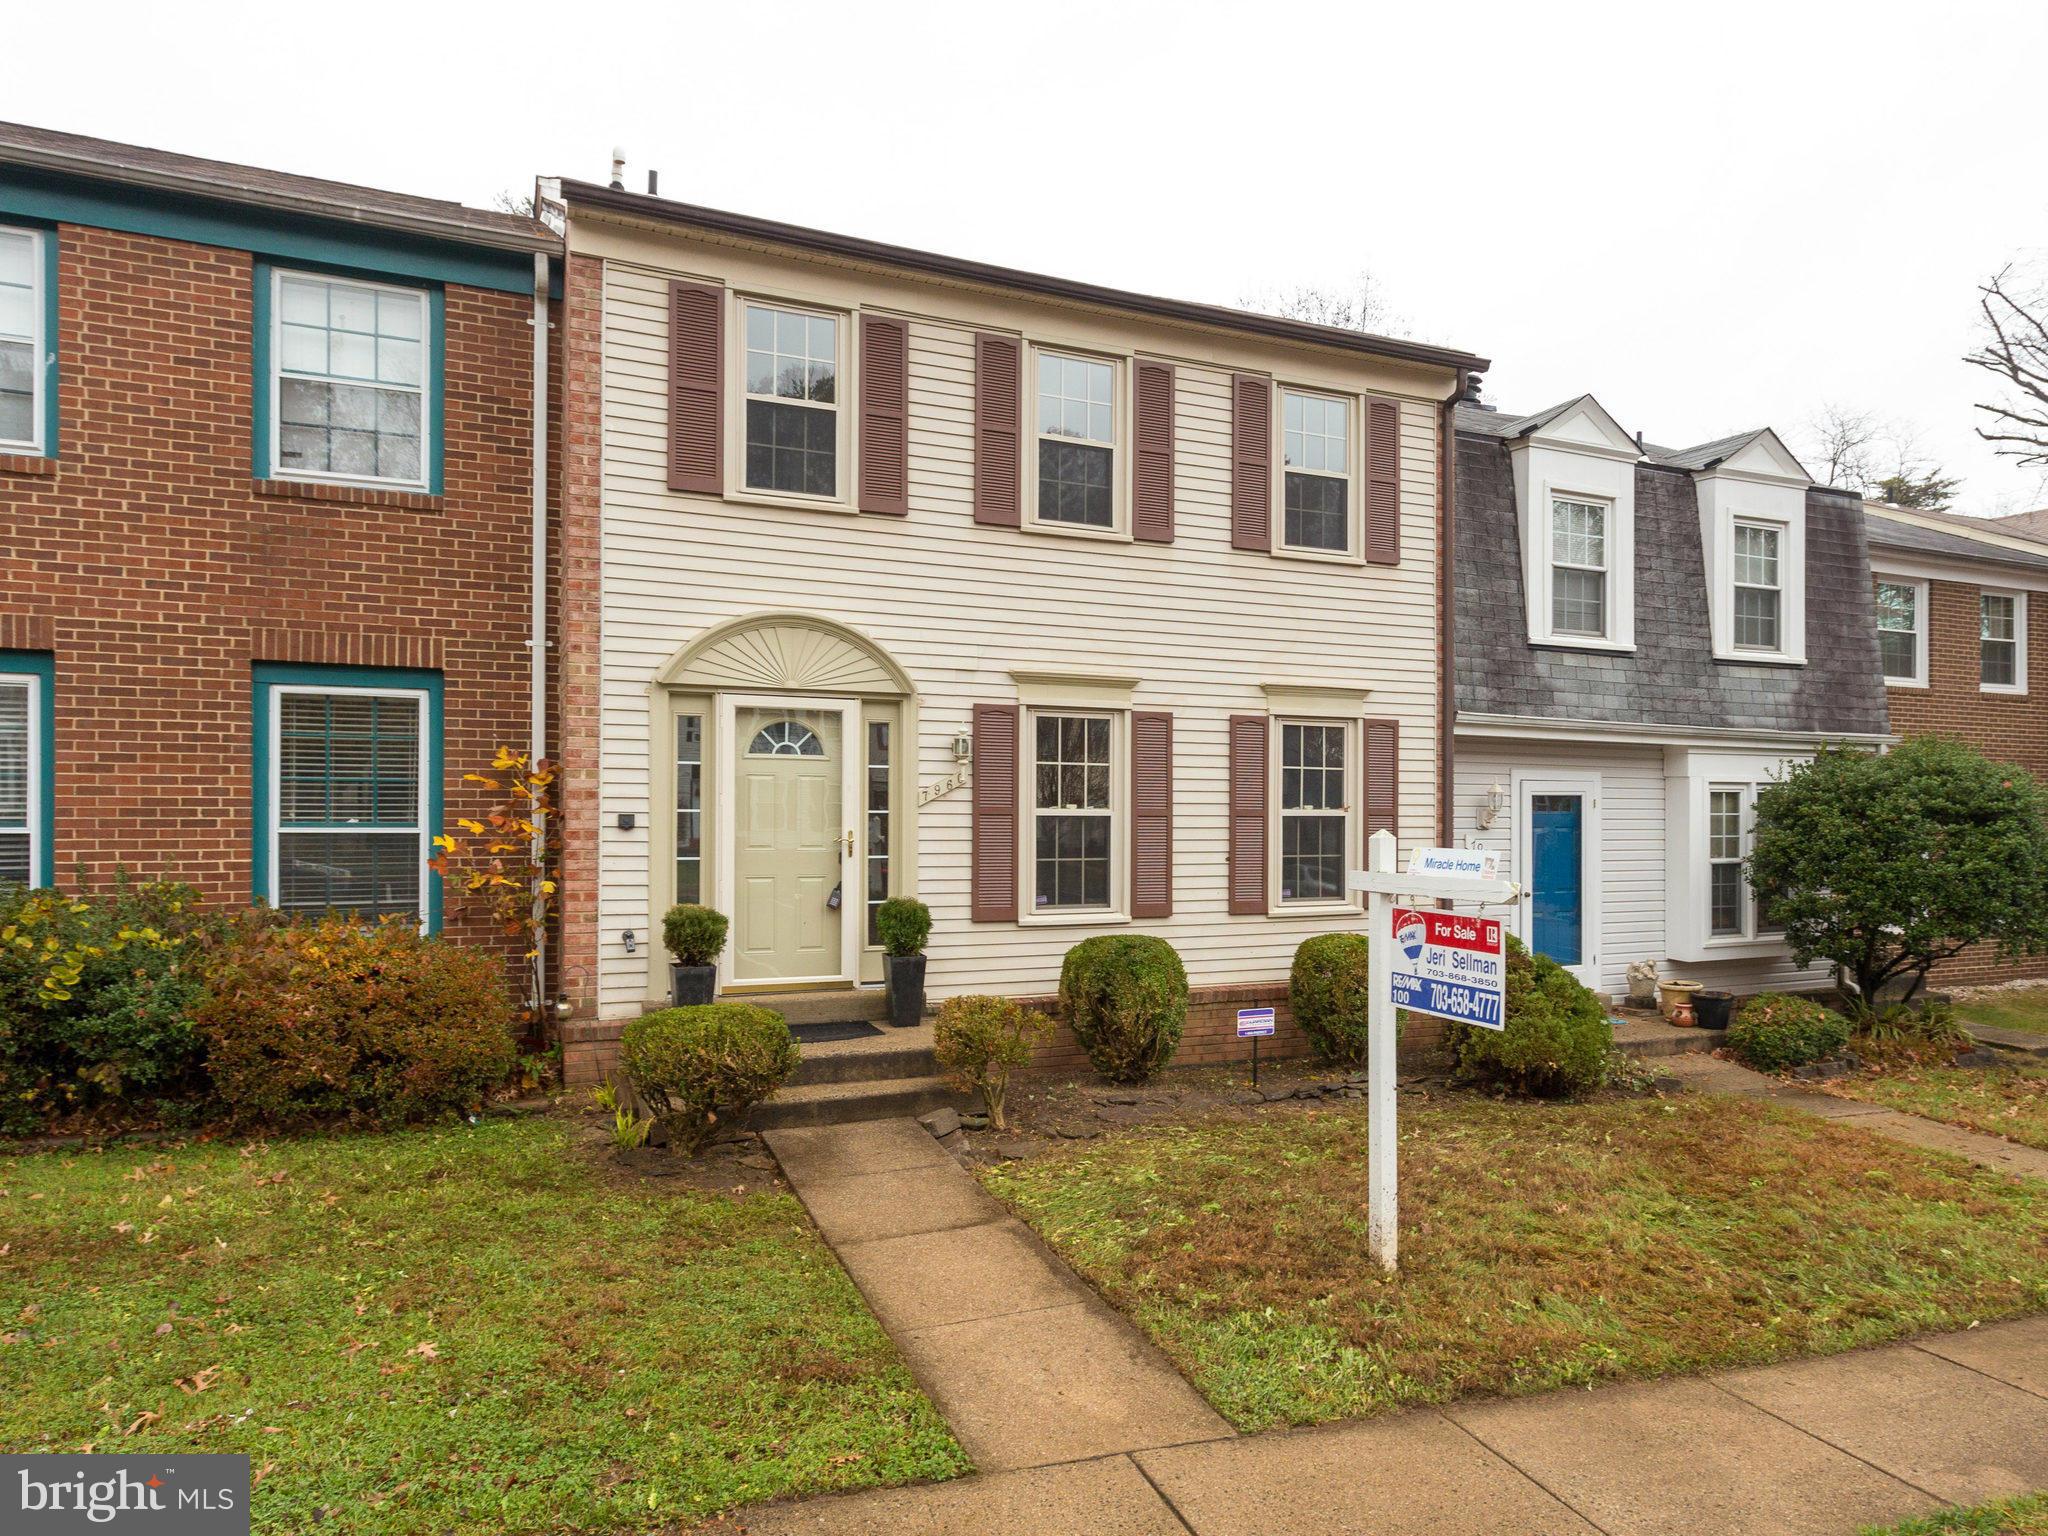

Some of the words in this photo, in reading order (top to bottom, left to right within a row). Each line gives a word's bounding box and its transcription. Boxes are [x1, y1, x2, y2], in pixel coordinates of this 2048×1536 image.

[1424, 857, 1453, 870] Miracle
[1455, 860, 1481, 872] Home
[1435, 922, 1451, 938] For
[1453, 925, 1477, 941] Sale
[1426, 947, 1446, 967] Jeri
[1452, 950, 1497, 976] Sellman
[1392, 973, 1422, 992] RE/MAX
[1426, 968, 1498, 988] 703-868-3850
[1392, 989, 1410, 1004] 100
[1430, 983, 1500, 1021] 703-658-4777
